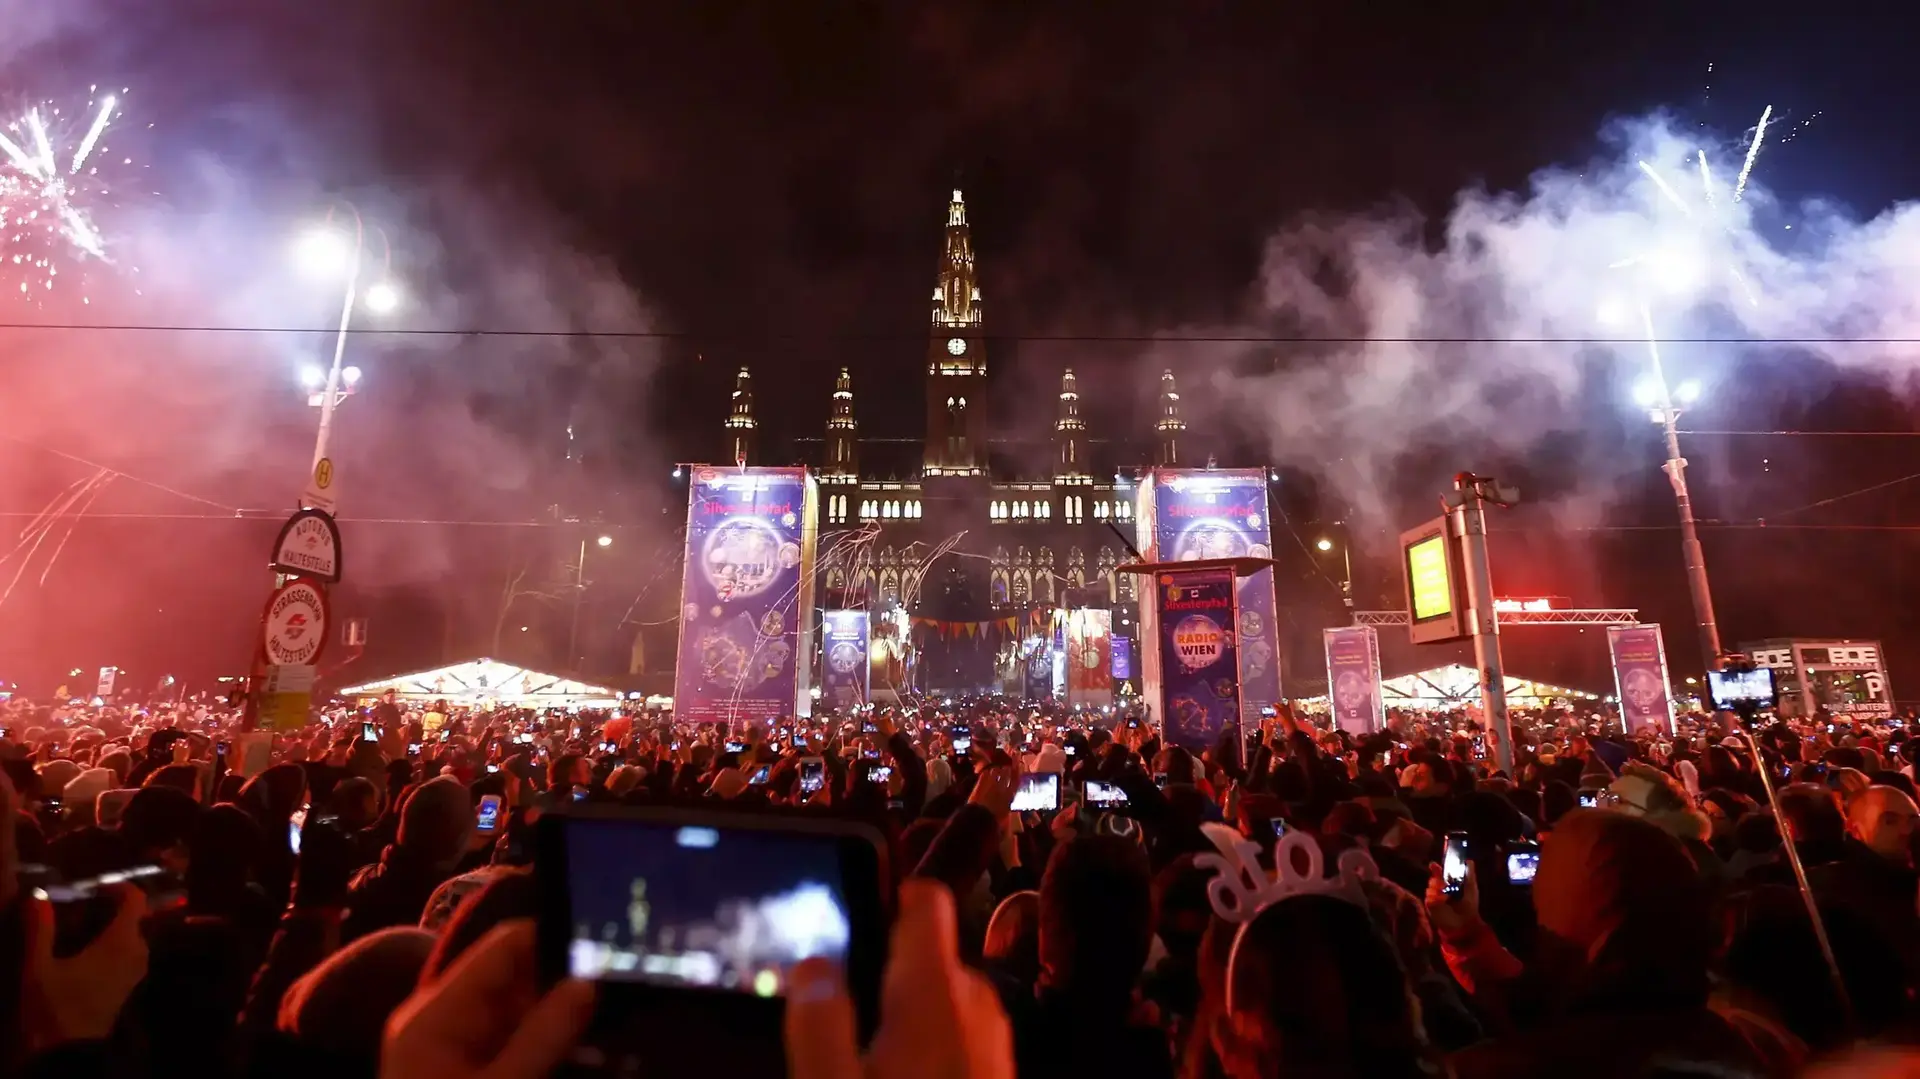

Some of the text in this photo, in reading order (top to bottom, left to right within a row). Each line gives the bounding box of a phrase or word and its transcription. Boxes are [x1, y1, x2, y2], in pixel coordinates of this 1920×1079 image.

[319, 463, 330, 484] H
[703, 500, 792, 515] Silvpfad
[1168, 503, 1255, 518] Silpfad
[297, 519, 331, 547] AUTOBUS
[284, 549, 332, 573] HALTESTELLE
[272, 588, 323, 622] STRASSENBAHN
[1177, 633, 1218, 644] RADIO
[269, 634, 316, 663] HALTESTELLE
[1181, 644, 1216, 656] WIEN
[1828, 646, 1877, 664] BOE
